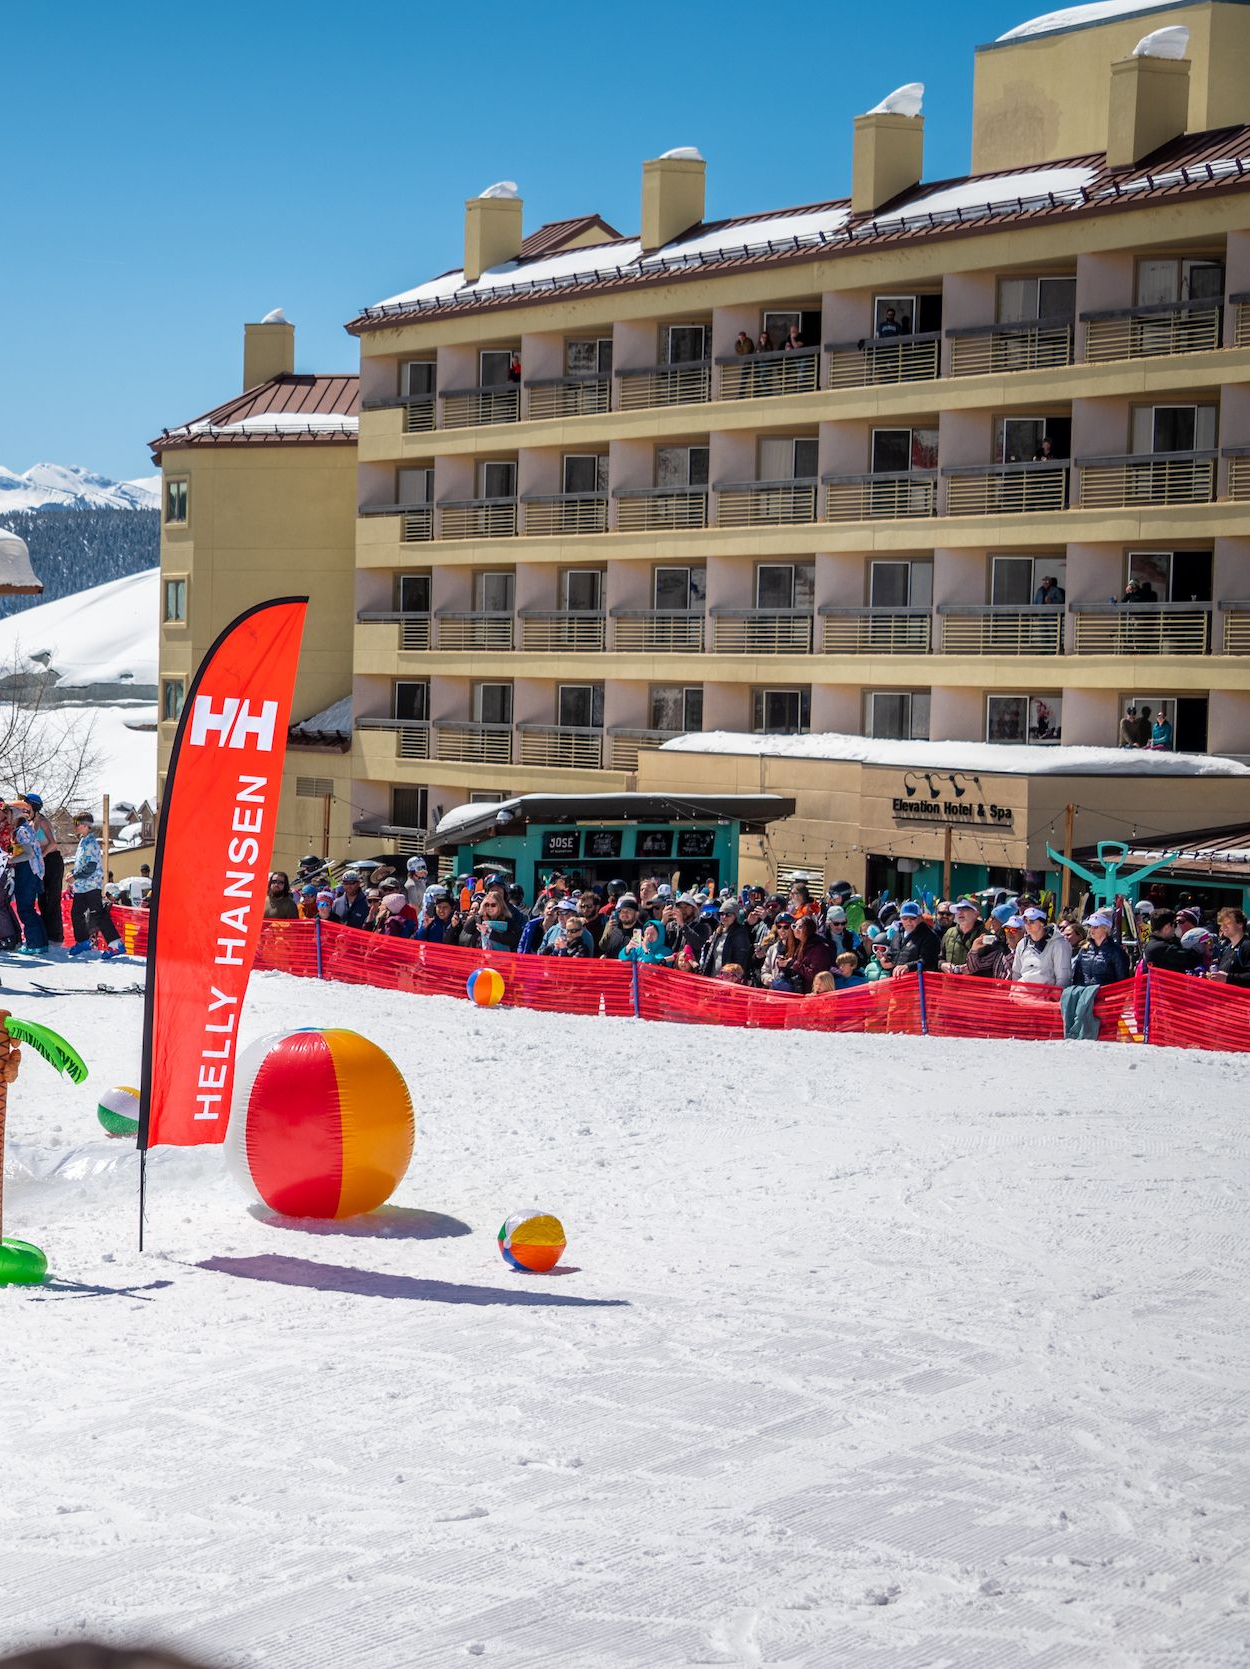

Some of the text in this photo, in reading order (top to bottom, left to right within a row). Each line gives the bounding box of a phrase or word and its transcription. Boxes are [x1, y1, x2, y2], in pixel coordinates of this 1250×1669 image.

[892, 799, 1012, 821] Elevation Hotel & Spa
[193, 775, 268, 1120] HELLY HANSEN
